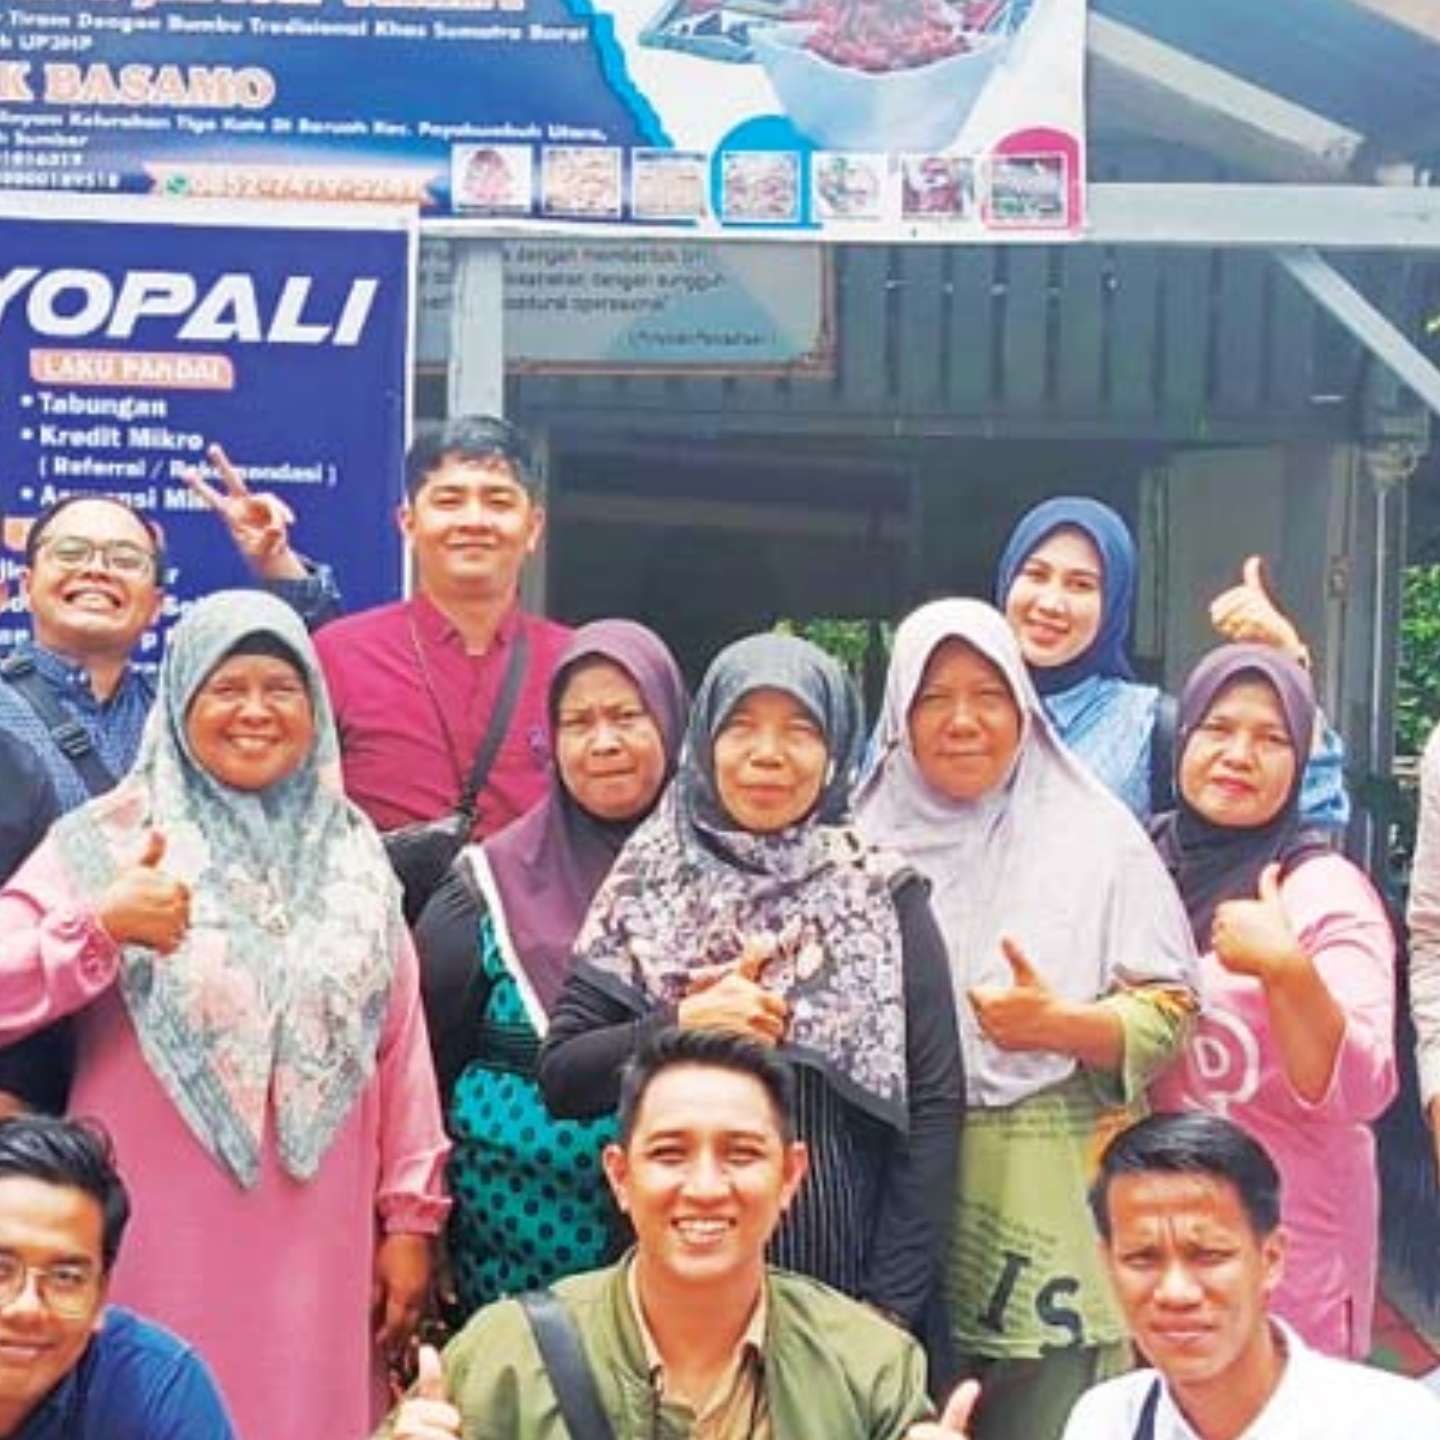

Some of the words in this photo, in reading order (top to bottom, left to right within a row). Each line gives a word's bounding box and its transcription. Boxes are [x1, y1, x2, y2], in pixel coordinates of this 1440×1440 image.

[42, 62, 276, 109] BASAMO
[43, 356, 108, 379] LAKU
[122, 358, 220, 383] PANDAI
[38, 392, 168, 421] Tabungan
[40, 424, 121, 448] Kredit
[129, 427, 205, 451] Mikro
